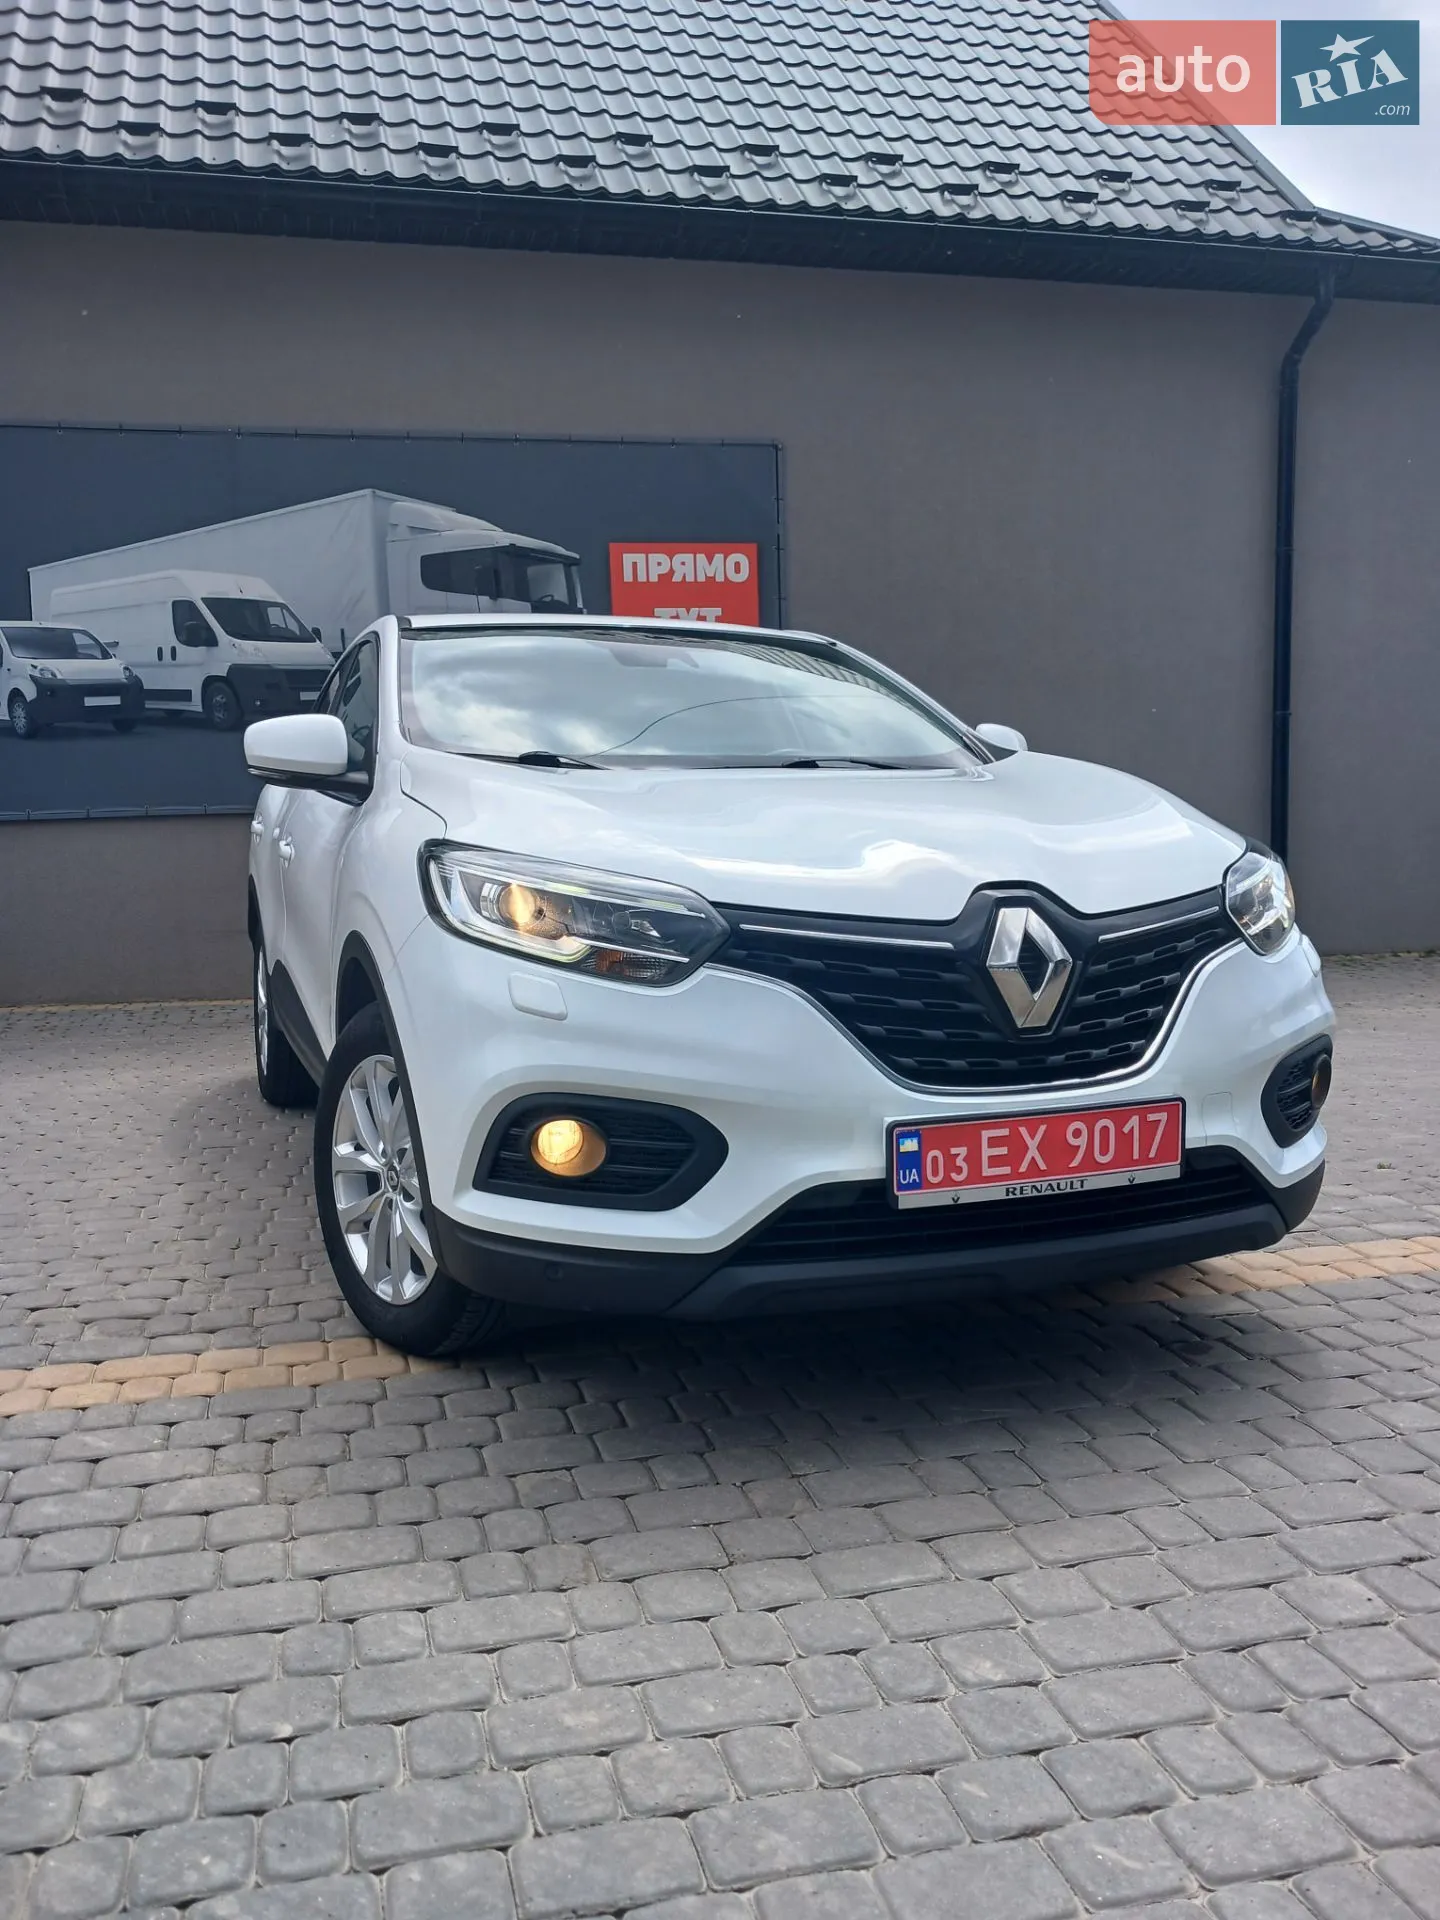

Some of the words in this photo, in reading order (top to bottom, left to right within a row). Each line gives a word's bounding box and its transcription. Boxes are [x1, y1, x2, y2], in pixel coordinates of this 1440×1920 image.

[622, 553, 750, 583] ПРЯМО
[1066, 1112, 1168, 1168] 9017
[900, 1169, 919, 1184] UA
[1005, 1178, 1088, 1197] RENAULT
